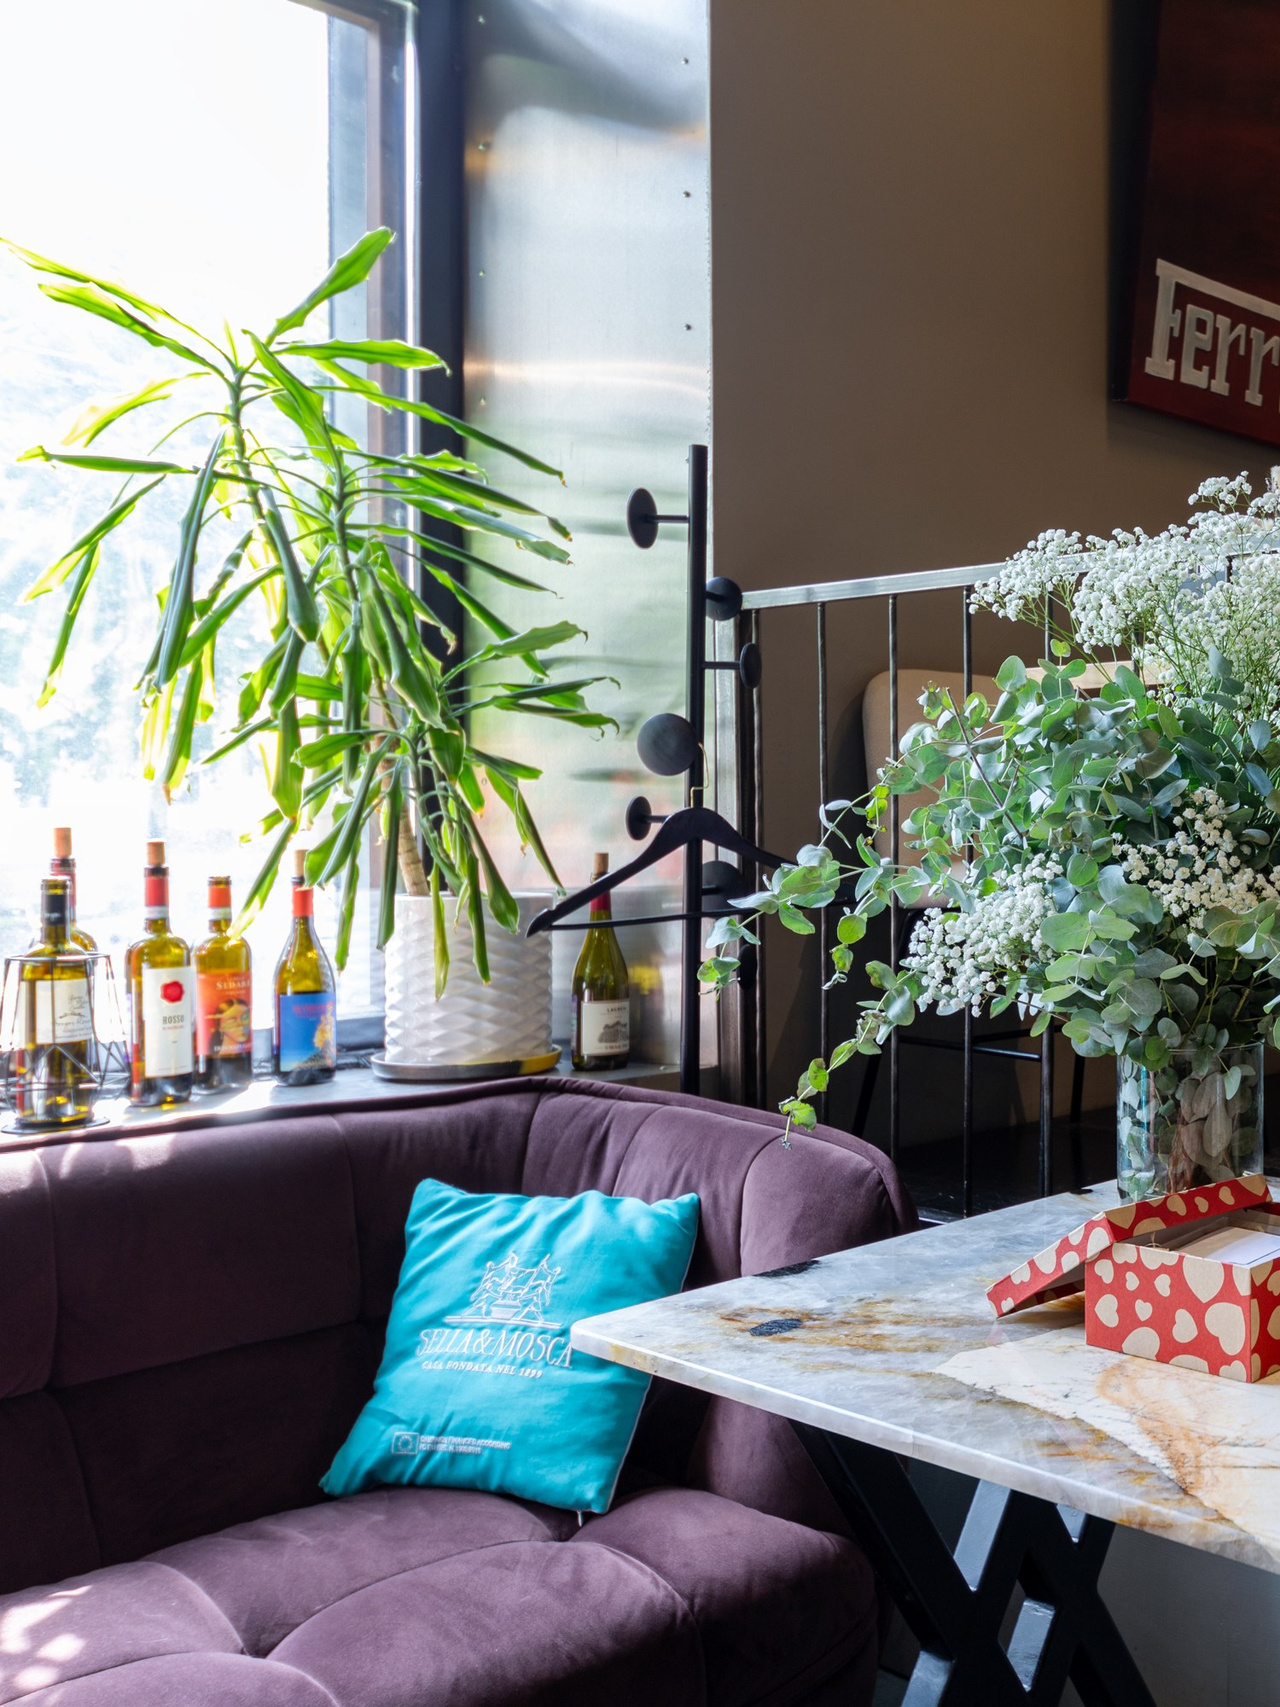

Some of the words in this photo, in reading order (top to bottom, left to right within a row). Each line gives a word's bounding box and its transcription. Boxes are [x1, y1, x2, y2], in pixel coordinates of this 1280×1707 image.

[162, 1014, 185, 1025] ROSSO
[416, 1328, 573, 1368] SELLA&MOSCA
[421, 1361, 443, 1370] CASA
[447, 1362, 492, 1373] FONDATA
[495, 1366, 516, 1375] NEL
[519, 1368, 543, 1378] 1899
